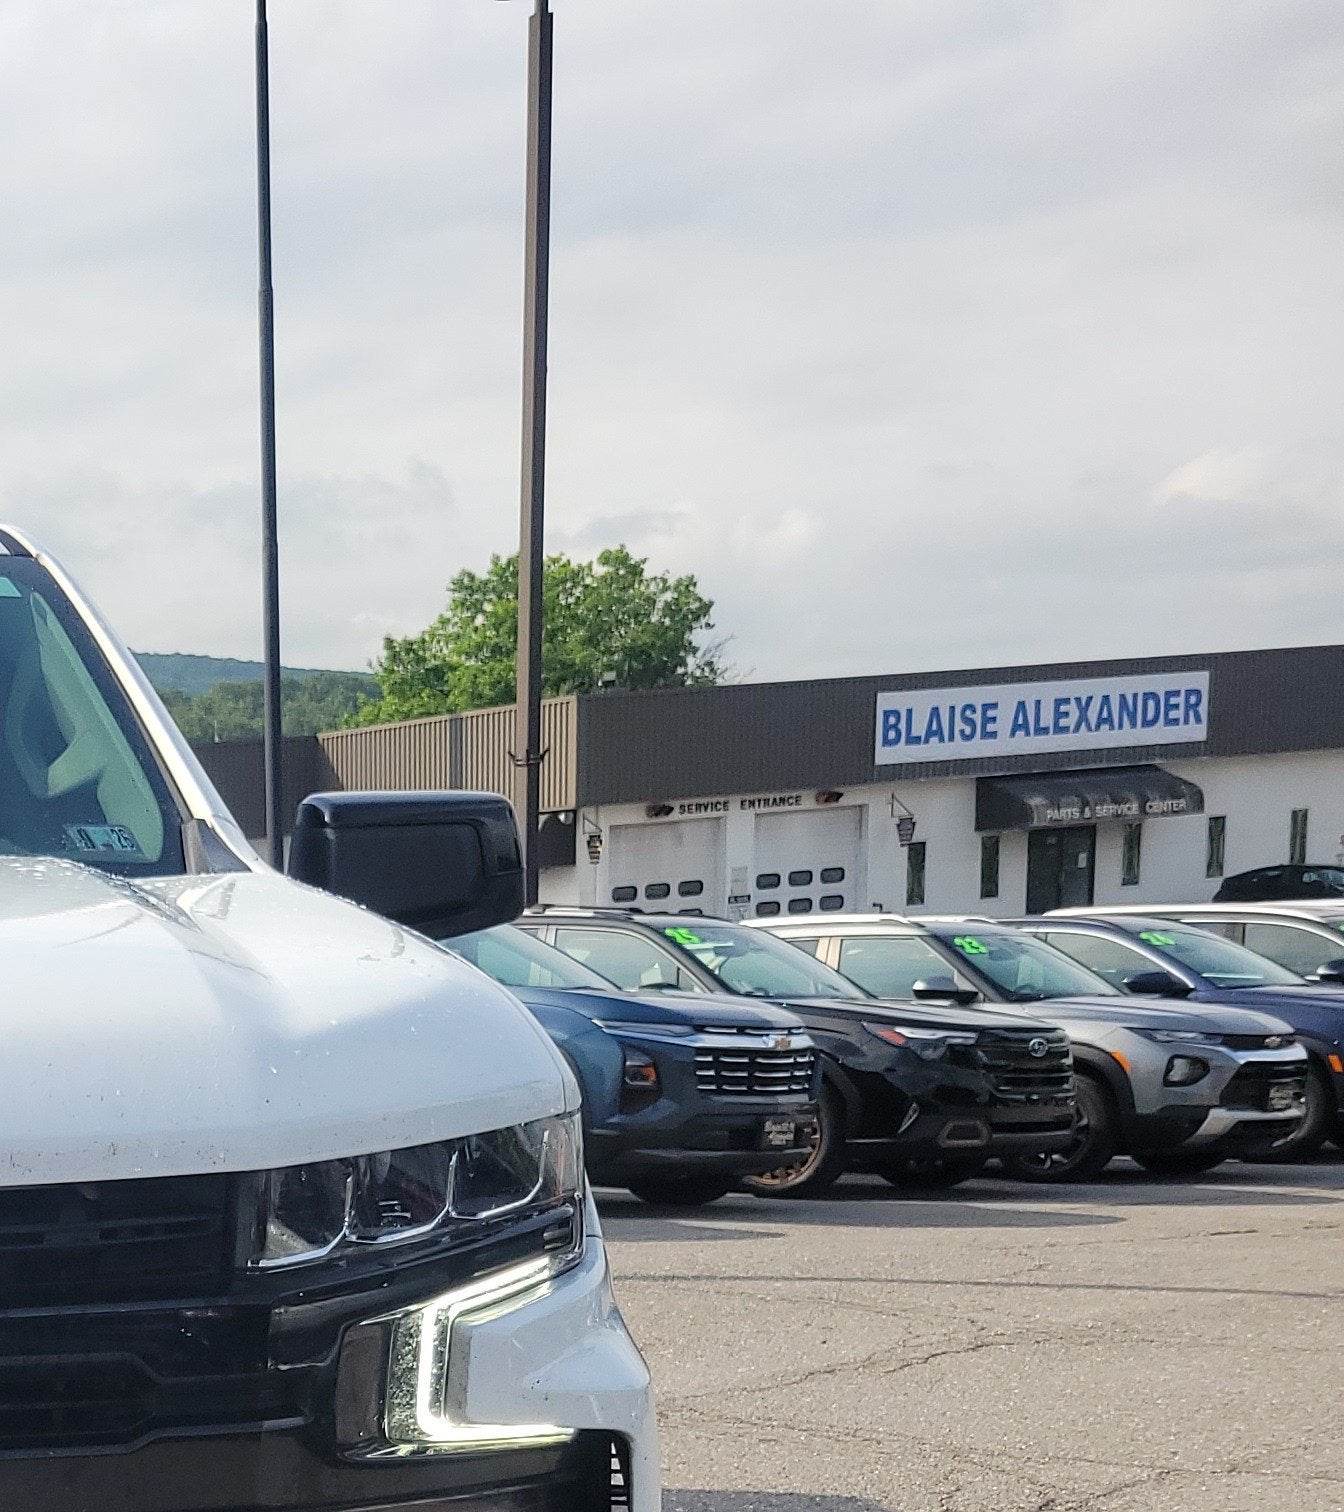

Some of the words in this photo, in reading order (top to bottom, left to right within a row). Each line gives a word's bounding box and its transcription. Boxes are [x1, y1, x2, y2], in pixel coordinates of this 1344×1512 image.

[881, 701, 999, 748] BLAISE
[1009, 688, 1203, 739] ALEXANDER
[678, 800, 729, 815] SERVICE
[740, 795, 803, 811] ENTRANCE
[1046, 807, 1080, 821] PARTS
[1095, 803, 1140, 818] SERVICE
[1145, 799, 1187, 814] CENTER
